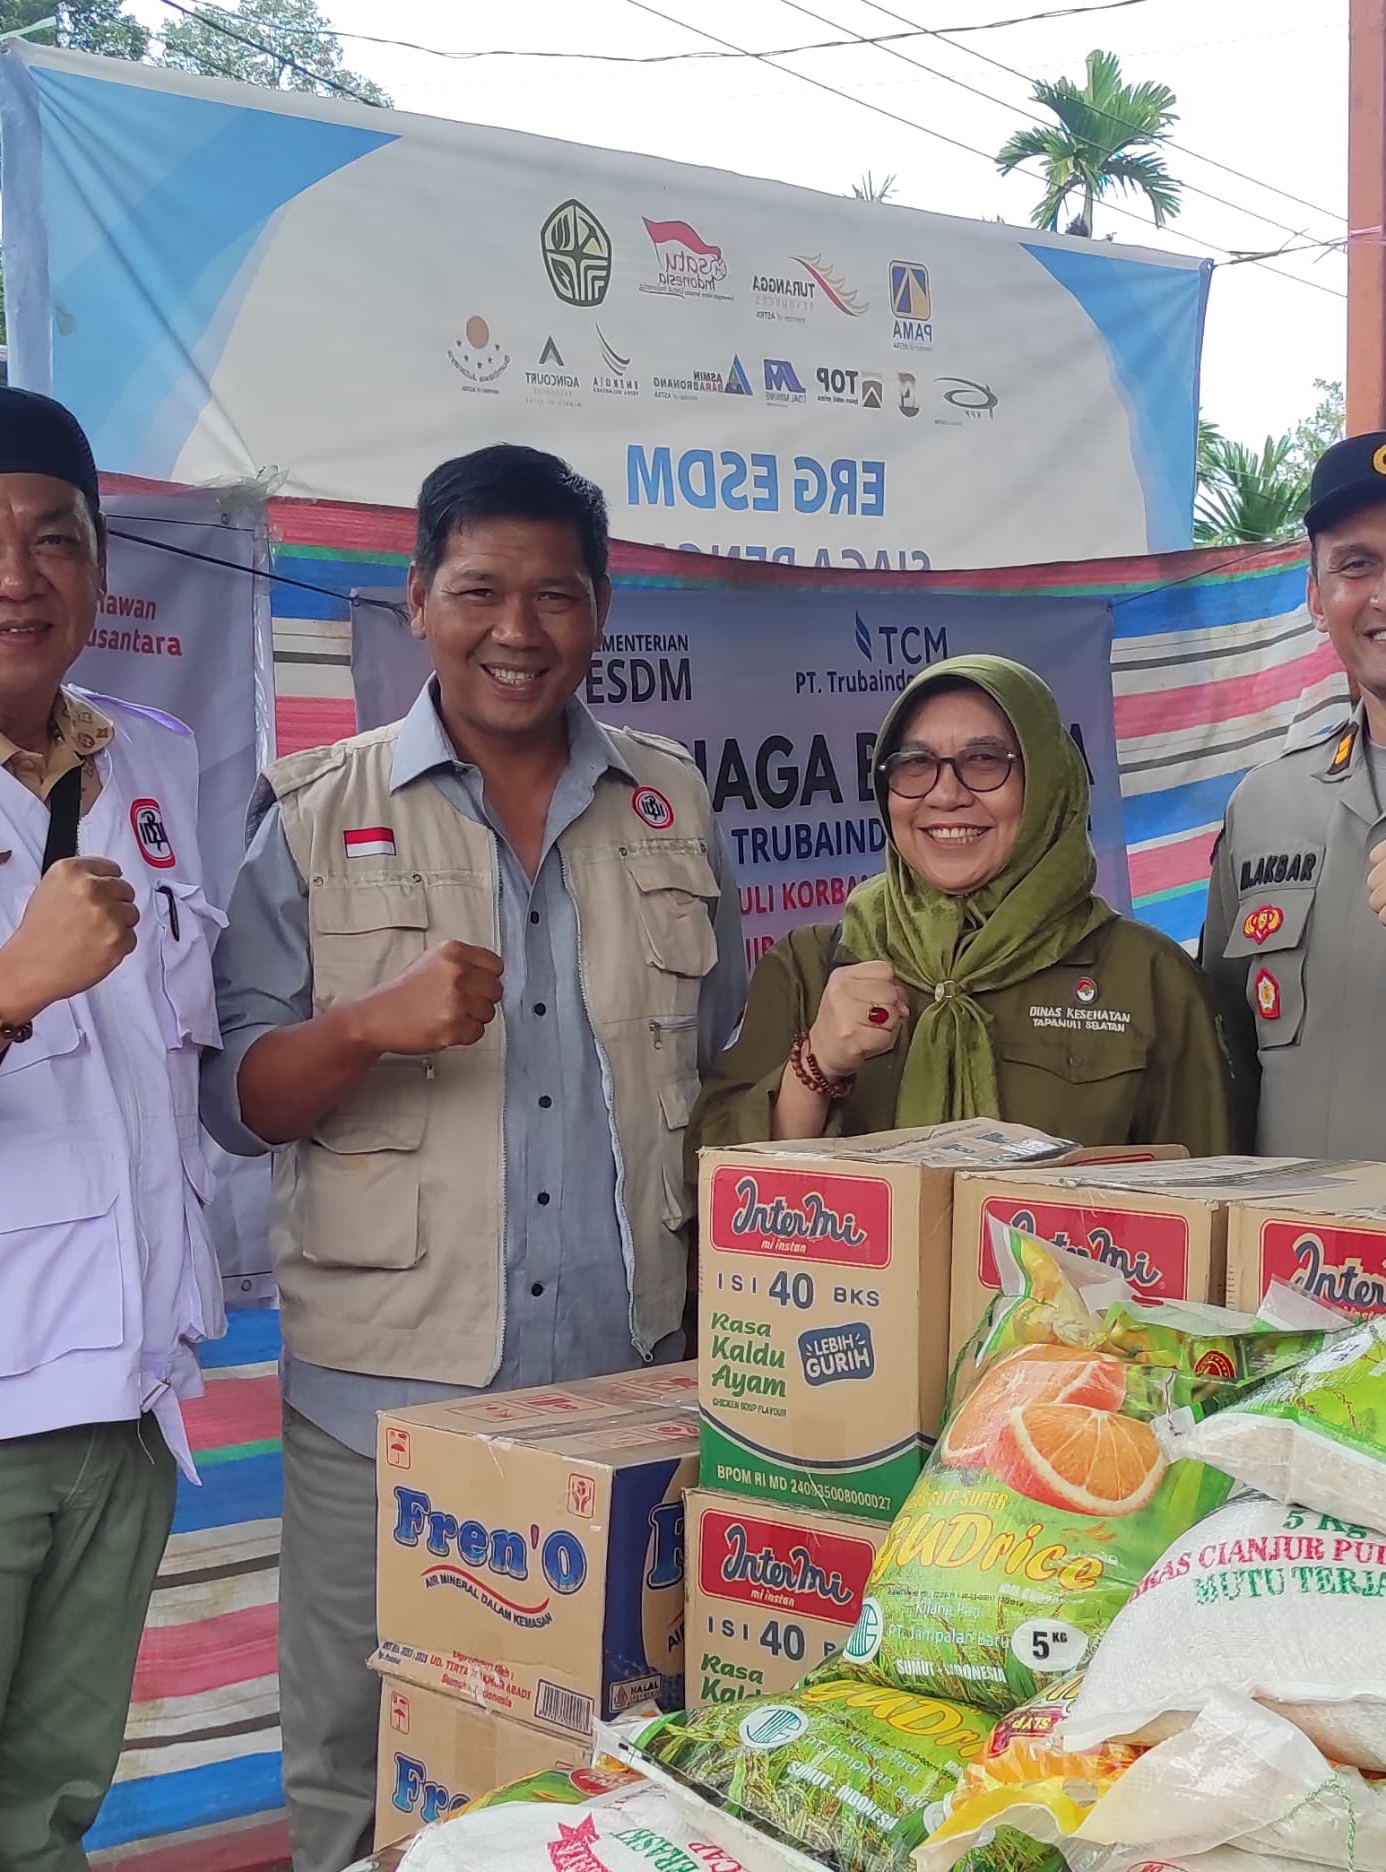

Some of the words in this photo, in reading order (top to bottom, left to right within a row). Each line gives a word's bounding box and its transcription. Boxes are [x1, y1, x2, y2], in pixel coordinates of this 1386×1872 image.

[99, 594, 156, 621] lawan
[87, 627, 182, 656] usantara
[594, 633, 689, 653] EMENTERIAN
[879, 627, 949, 664] TCM
[587, 658, 692, 704] ESDM
[795, 672, 823, 694] PT.
[692, 732, 848, 814] IAGA
[730, 816, 886, 866] TRUBAIND
[738, 884, 774, 916] ULI
[1029, 1006, 1062, 1018] DINAS
[1066, 1007, 1131, 1023] KESEHATAN
[775, 1240, 807, 1255] instan
[717, 1272, 759, 1295] ISI
[768, 1269, 815, 1310] 40
[833, 1286, 881, 1308] BKS
[711, 1312, 773, 1339] Rasa
[711, 1335, 787, 1370] Kaldu
[813, 1334, 857, 1357] LEBIH
[805, 1349, 870, 1378] GURIH
[711, 1364, 787, 1399] Ayam
[717, 1464, 752, 1487] BPOM
[769, 1474, 788, 1492] MD
[1283, 1510, 1305, 1531] 5
[393, 1485, 587, 1597] Fren'O
[1198, 1535, 1326, 1571] CIANJUR
[425, 1574, 440, 1589] AIR
[440, 1572, 480, 1600] MINERAL
[480, 1593, 513, 1622] DALAM
[512, 1611, 554, 1629] KEMASAN
[762, 1590, 796, 1608] instan
[1195, 1567, 1287, 1607] MUTU
[708, 1615, 749, 1641] ISI
[759, 1620, 806, 1662] 40
[1031, 1630, 1051, 1661] 5
[1051, 1632, 1068, 1644] KG
[700, 1653, 764, 1685] Rasa
[896, 1659, 936, 1678] SUMUT
[786, 1760, 834, 1790] SUMUT
